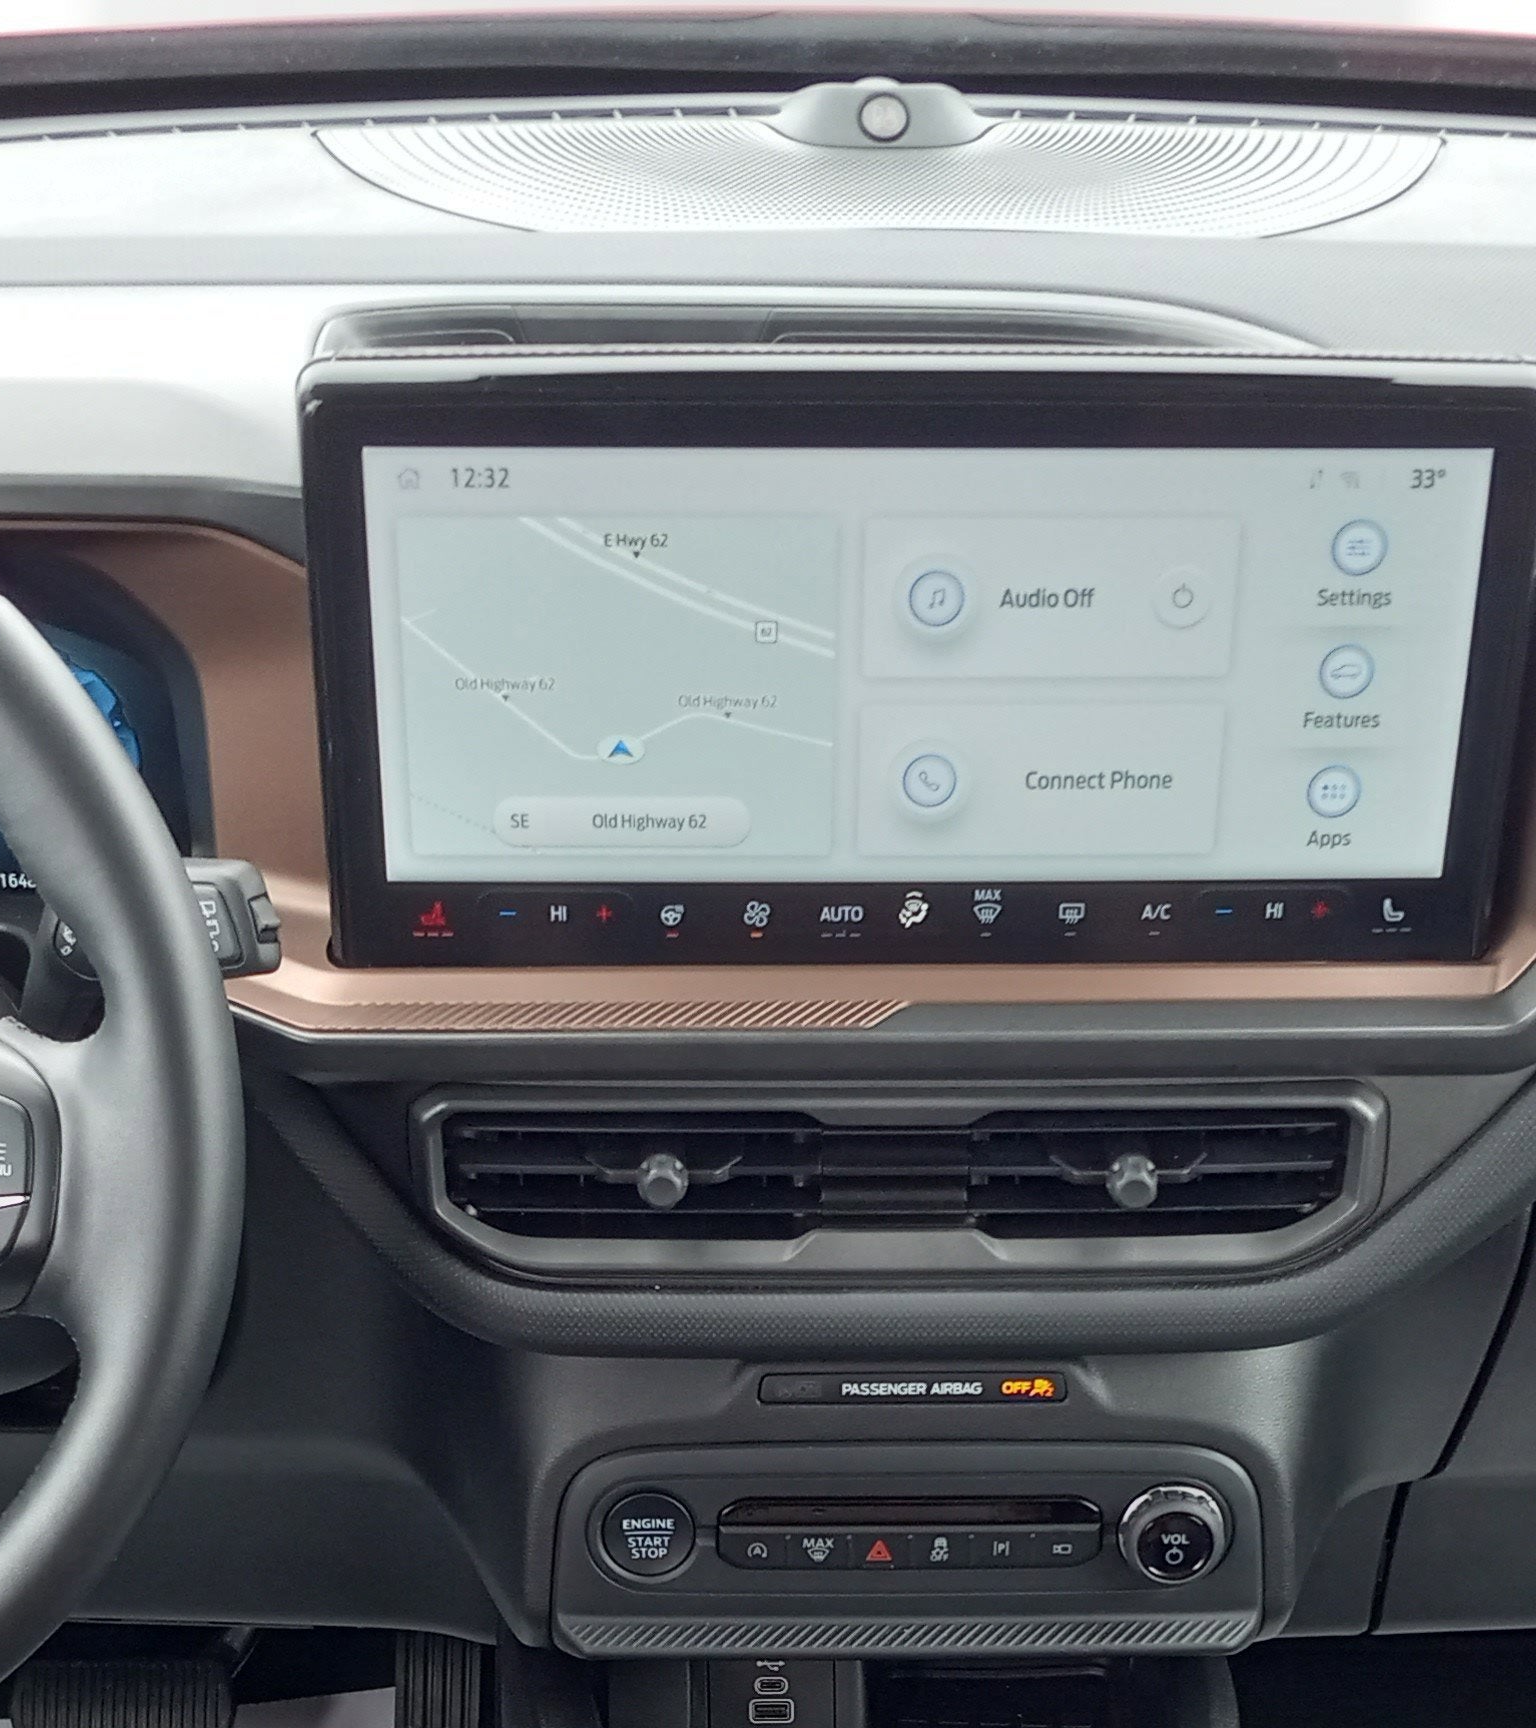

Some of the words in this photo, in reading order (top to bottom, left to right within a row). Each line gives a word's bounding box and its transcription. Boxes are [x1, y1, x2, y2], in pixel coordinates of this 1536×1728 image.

[451, 467, 510, 489] 12:32
[1410, 469, 1446, 489] 33°
[604, 533, 613, 548] E
[616, 533, 648, 551] Hwy
[651, 533, 669, 548] 62
[999, 588, 1060, 608] Audio
[1063, 588, 1095, 608] Off
[1317, 588, 1392, 609] Settings
[455, 677, 476, 692] Old
[479, 677, 535, 695] Highway
[538, 677, 555, 691] 62
[677, 694, 700, 709] Old
[703, 694, 758, 712] Highway
[1303, 711, 1380, 730] Features
[1025, 770, 1105, 790] Connect
[1110, 770, 1173, 790] Phone
[510, 814, 530, 830] SE
[592, 814, 619, 830] Old
[622, 814, 686, 834] Highway
[688, 814, 707, 830] 62
[1306, 829, 1351, 849] Apps
[974, 889, 1002, 901] MAX
[550, 906, 567, 922] HI
[820, 906, 864, 922] AUTO
[1141, 904, 1171, 921] A/C
[1265, 902, 1284, 919] HI
[842, 1382, 927, 1396] PASSENGER
[929, 1382, 983, 1396] AIRBAG
[1001, 1381, 1032, 1396] OFF
[622, 1518, 675, 1531] ENGINE
[628, 1536, 670, 1548] START
[802, 1538, 834, 1549] MAX
[1162, 1534, 1189, 1545] VOL
[631, 1548, 667, 1559] STOP
